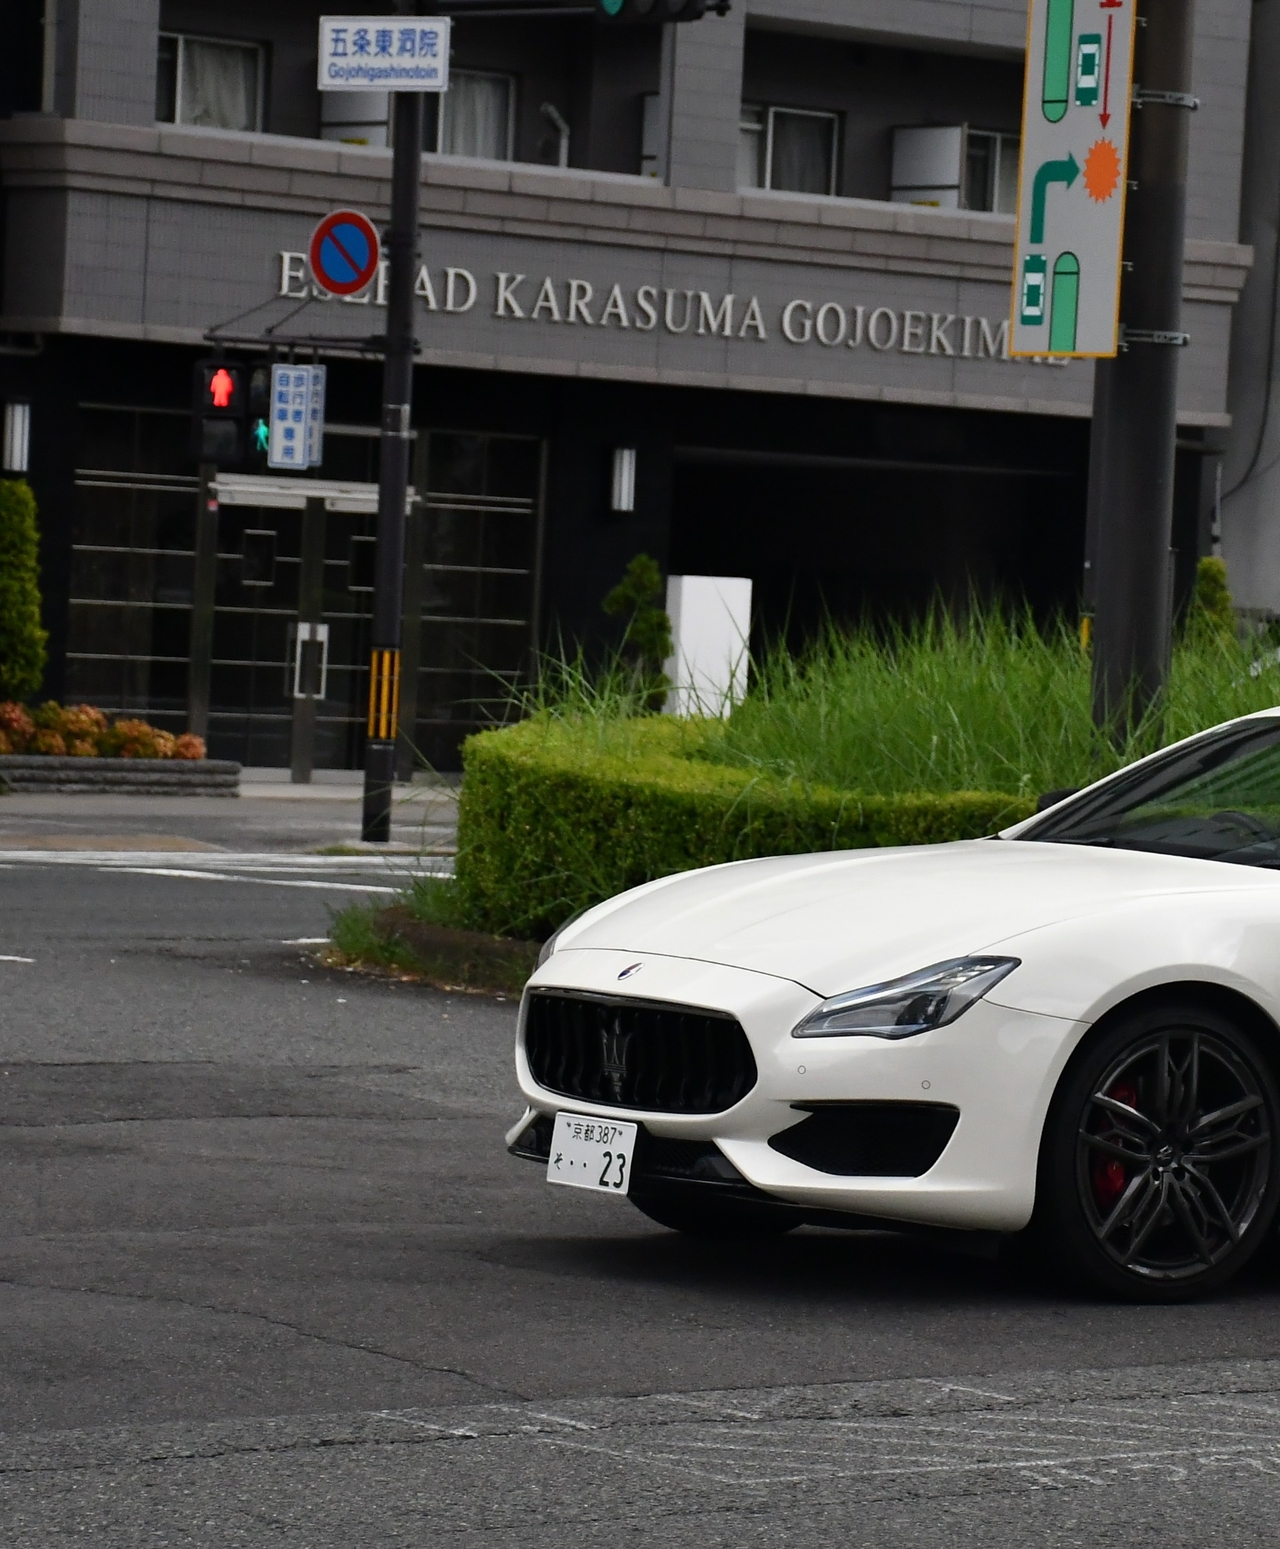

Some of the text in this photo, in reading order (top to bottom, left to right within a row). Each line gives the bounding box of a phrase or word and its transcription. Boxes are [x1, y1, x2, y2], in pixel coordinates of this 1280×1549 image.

[329, 28, 439, 58] 五条東洞院
[328, 62, 438, 81] Gojohigashinotoin
[279, 250, 1069, 367] EAD KARASUMA GOJOEKIM
[553, 1152, 564, 1170] そ
[598, 1151, 626, 1188] 23
